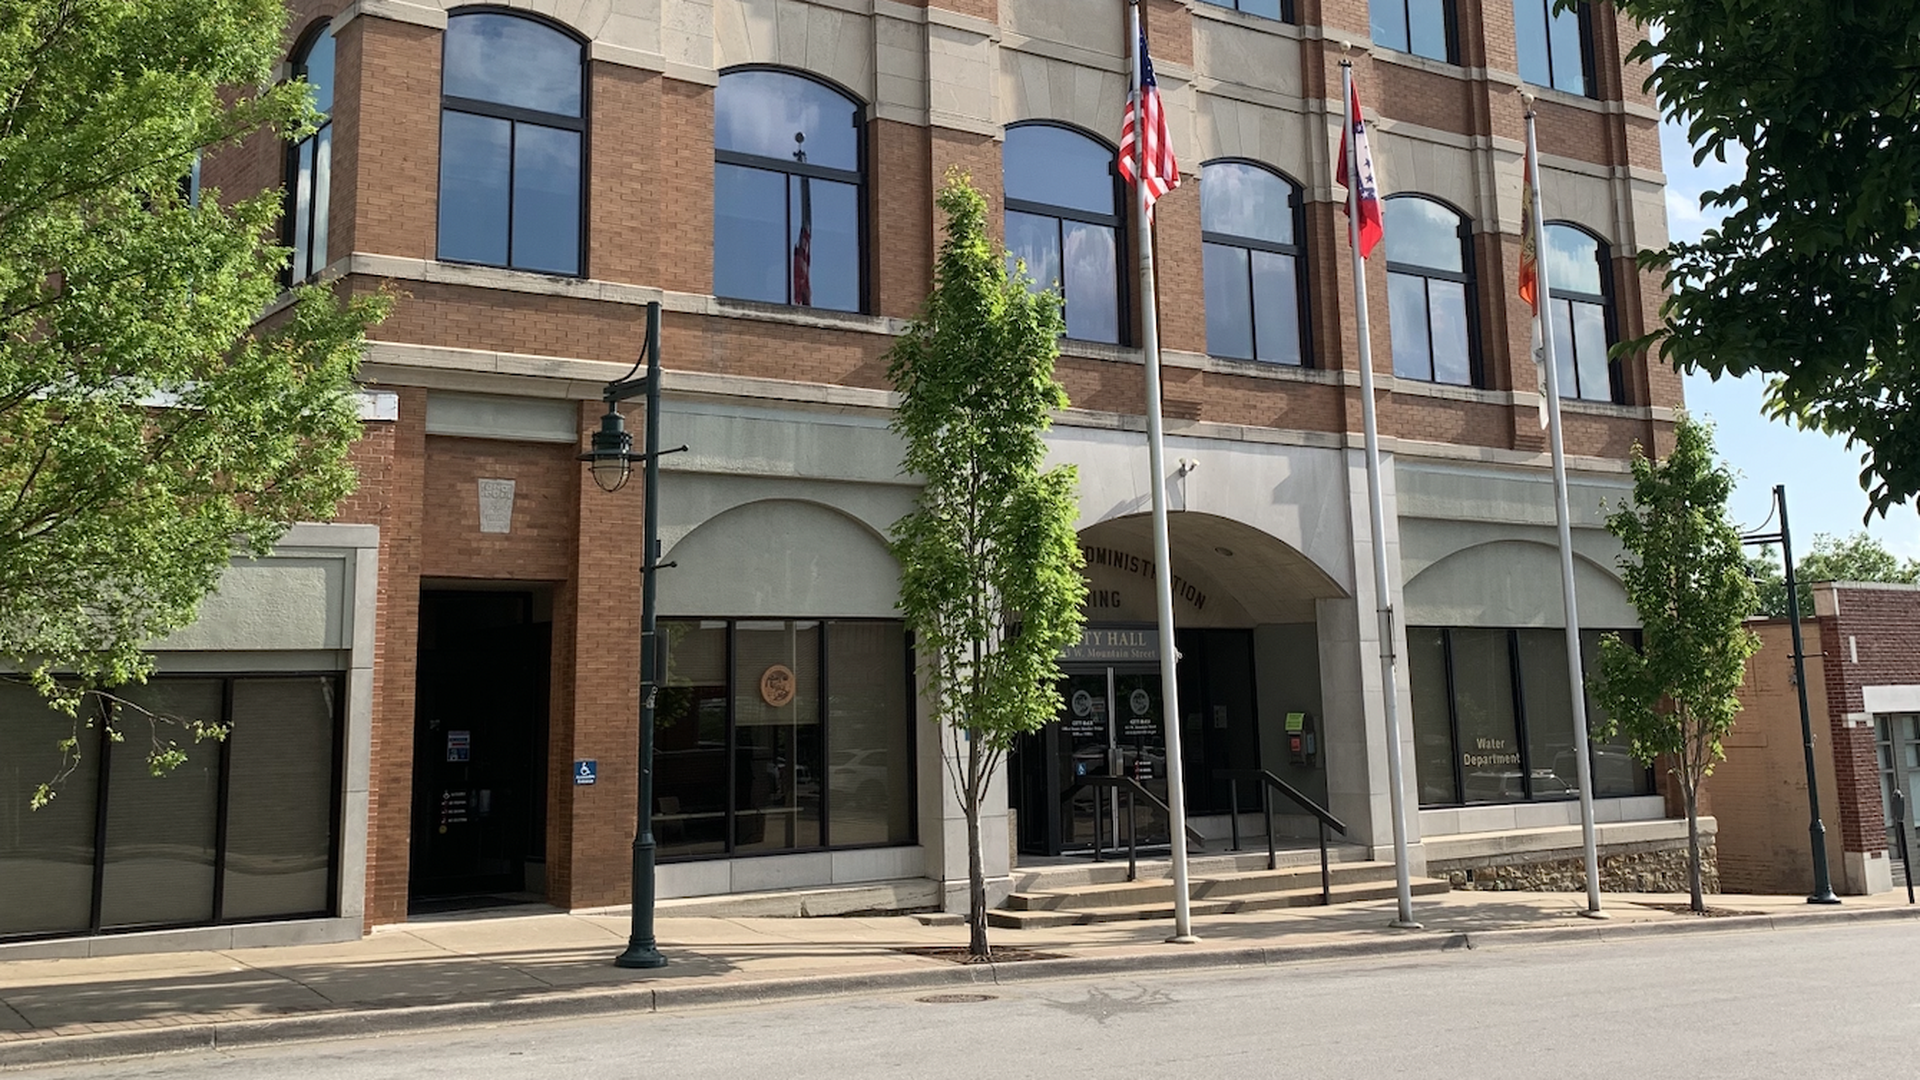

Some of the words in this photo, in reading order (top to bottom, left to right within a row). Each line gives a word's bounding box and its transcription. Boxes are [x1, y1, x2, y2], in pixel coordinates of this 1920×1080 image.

[1083, 545, 1206, 611] DMINISTTION
[1083, 631, 1102, 646] TY
[1107, 631, 1147, 647] HALL
[1087, 647, 1129, 659] Mountain
[1131, 648, 1156, 659] Street
[1476, 738, 1505, 749] Water
[1463, 753, 1520, 767] Department
